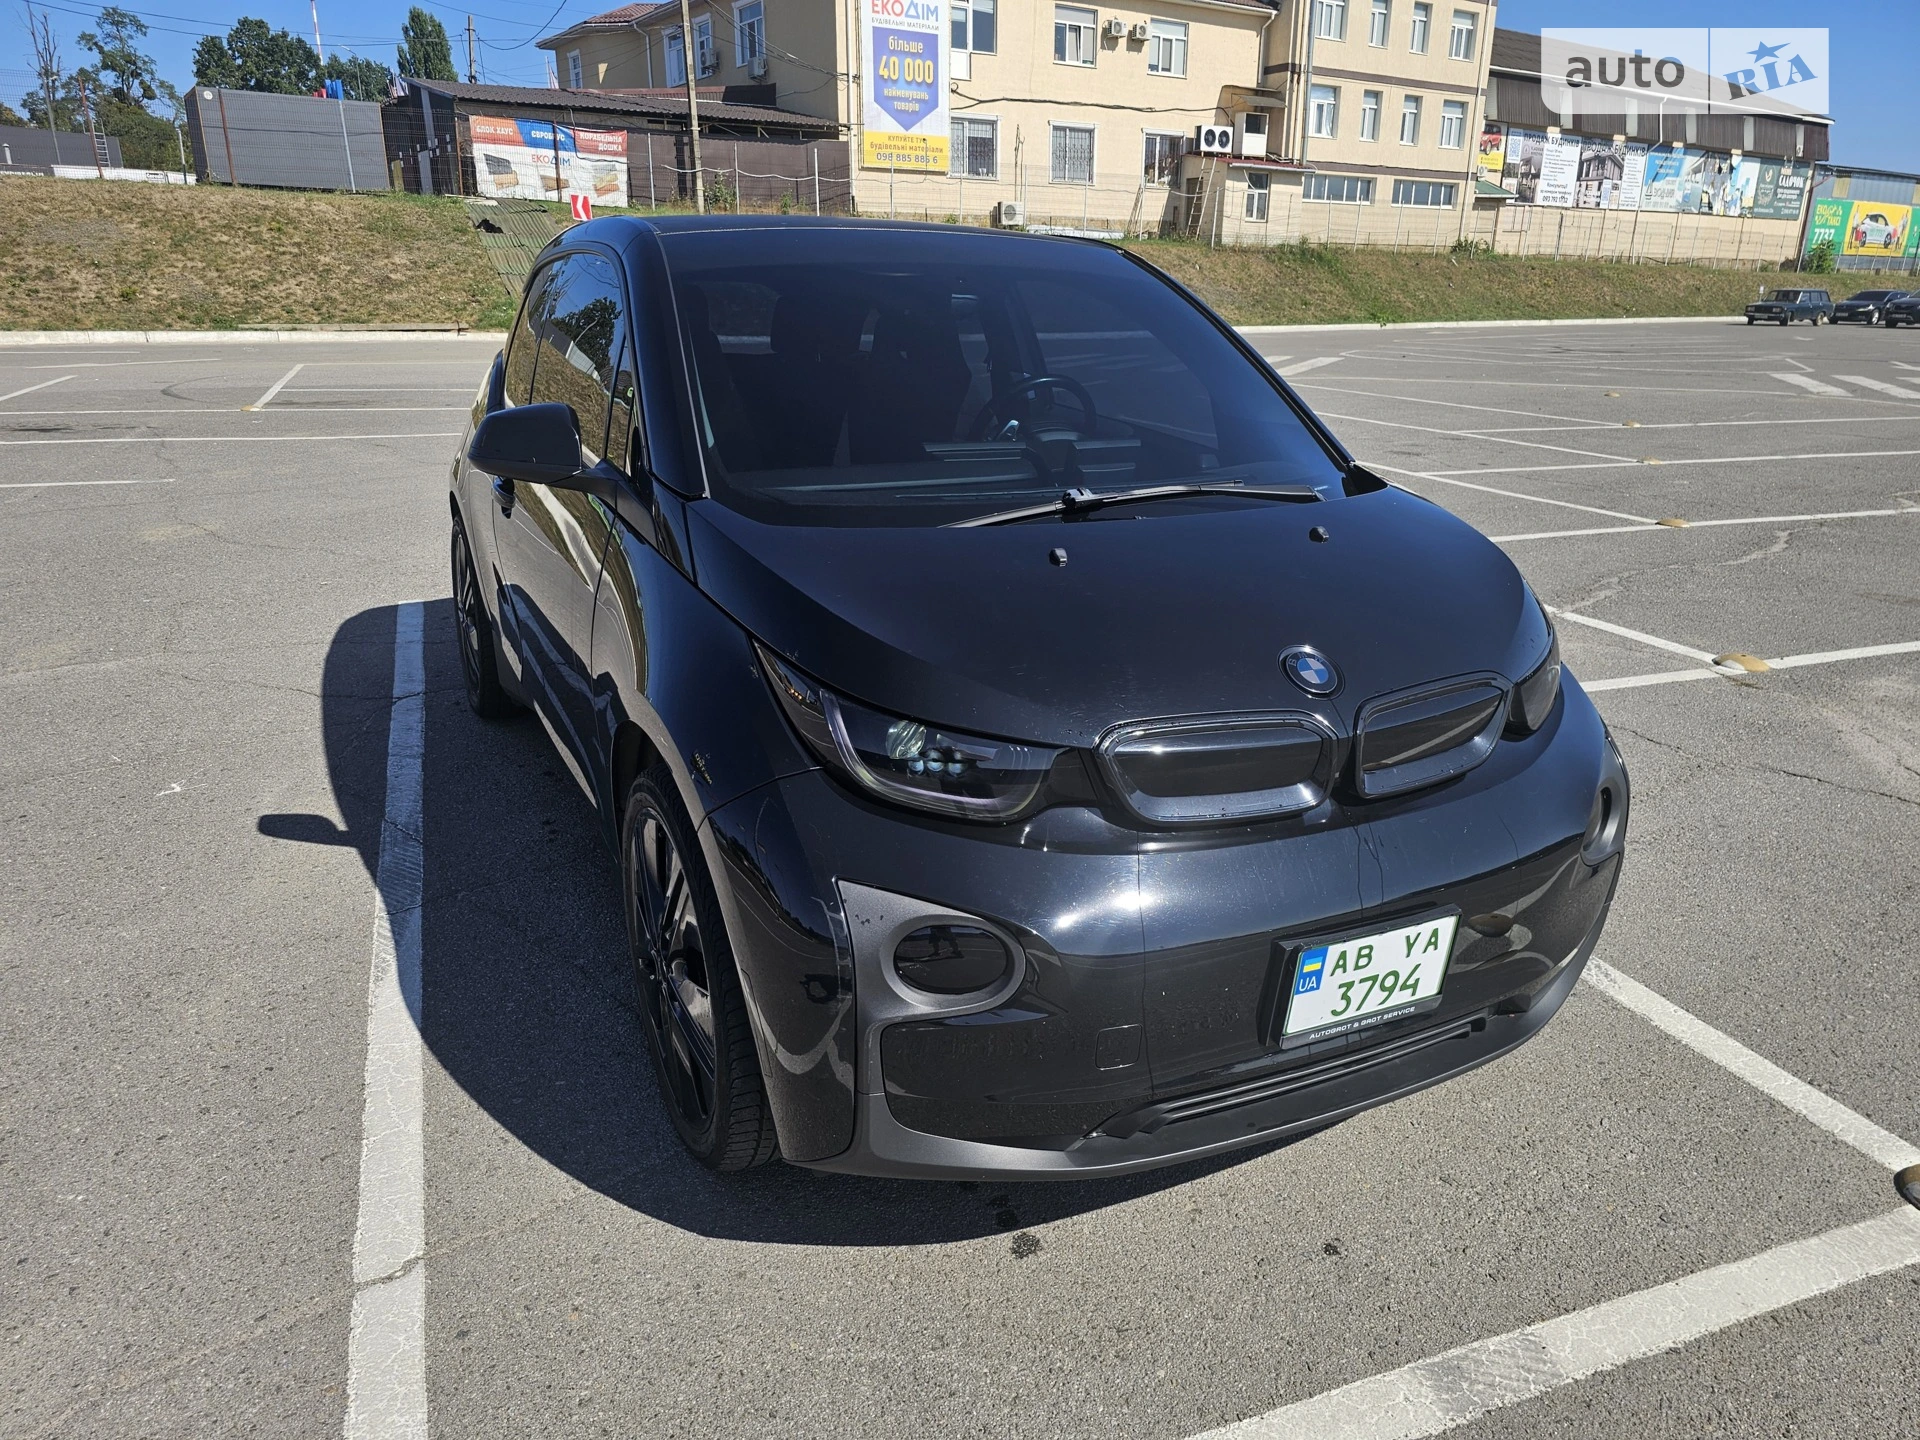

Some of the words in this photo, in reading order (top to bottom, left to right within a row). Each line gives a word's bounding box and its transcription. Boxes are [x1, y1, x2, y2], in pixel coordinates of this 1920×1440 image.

[872, 17, 905, 26] БУДІВЕЛЬНІ
[907, 22, 939, 31] МАТЕРІАЛИ
[888, 35, 923, 53] більше
[879, 55, 899, 80] 40
[904, 58, 934, 84] 000
[883, 86, 929, 100] найменувань
[893, 101, 920, 112] товарів
[496, 127, 514, 136] ХАУС
[531, 130, 566, 141] ЄВРОБУС
[579, 132, 622, 143] КОРАБЕЛЬНА
[870, 141, 907, 151] будівельні
[888, 134, 914, 143] КУПУЙТЕ
[916, 137, 927, 145] ТУ
[598, 143, 622, 152] ДОШКА
[896, 153, 912, 163] 885
[932, 156, 938, 164] 6
[1288, 652, 1324, 667] BMW
[1329, 944, 1374, 977] AB
[1405, 927, 1440, 958] YA
[1299, 976, 1317, 992] UA
[1331, 963, 1422, 1017] 3794
[1309, 1023, 1352, 1040] AUTOGROT
[1383, 1006, 1416, 1020] SERVICE
